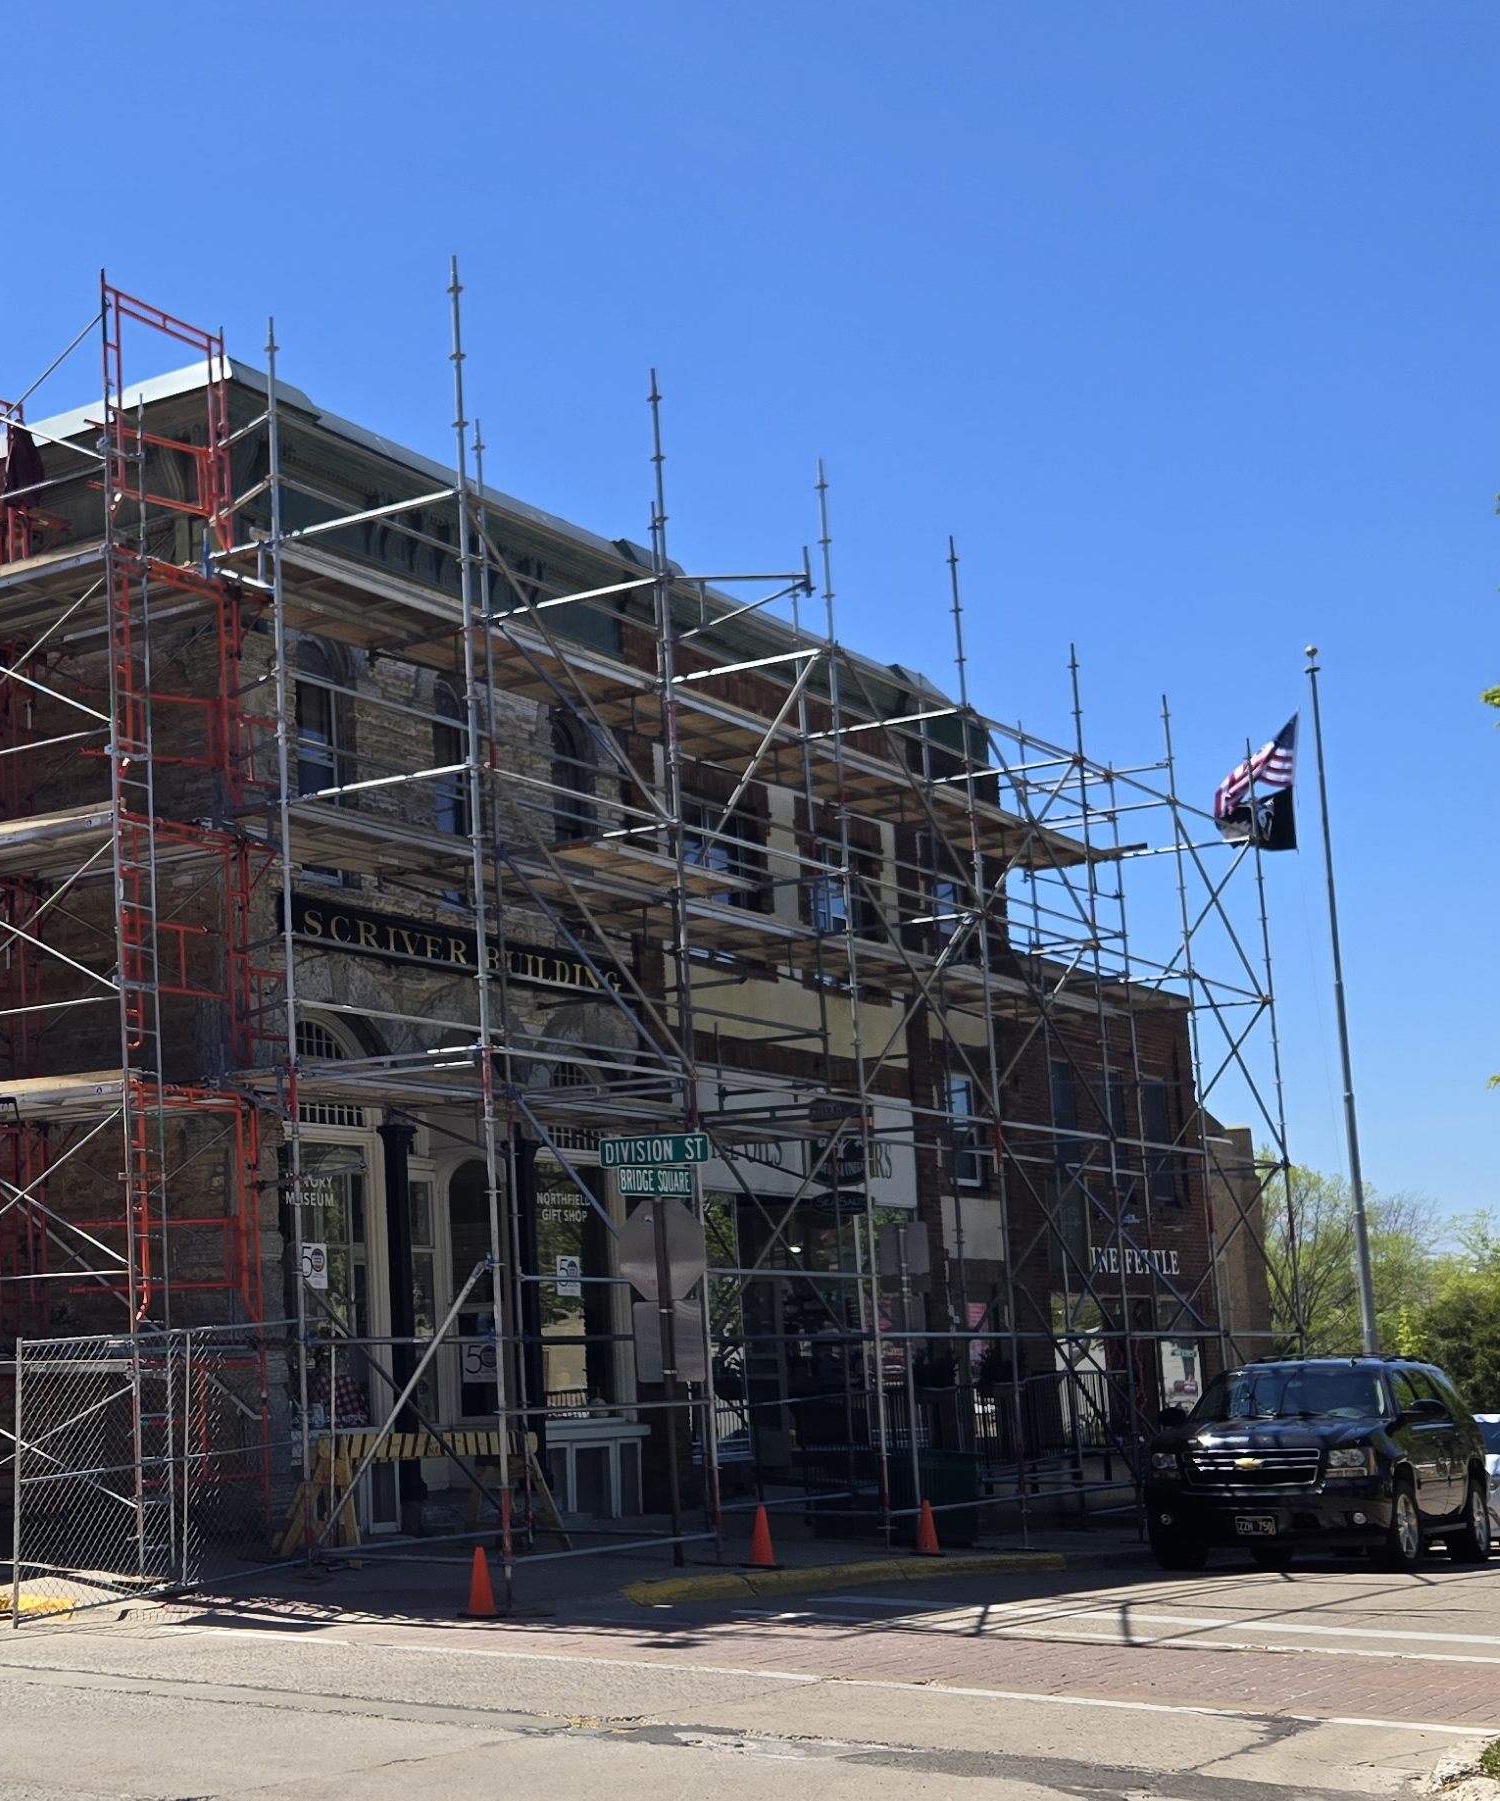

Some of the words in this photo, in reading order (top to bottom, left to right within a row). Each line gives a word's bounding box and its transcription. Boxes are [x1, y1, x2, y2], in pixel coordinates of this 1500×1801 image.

[303, 908, 468, 965] SCRIVER
[485, 946, 622, 992] BUILDING
[605, 1139, 674, 1164] DIVISION
[684, 1137, 703, 1160] ST
[620, 1168, 654, 1191] BRIDGE
[657, 1170, 691, 1193] SQUARE
[541, 1208, 563, 1222] GIFT
[563, 1209, 588, 1223] SHOP
